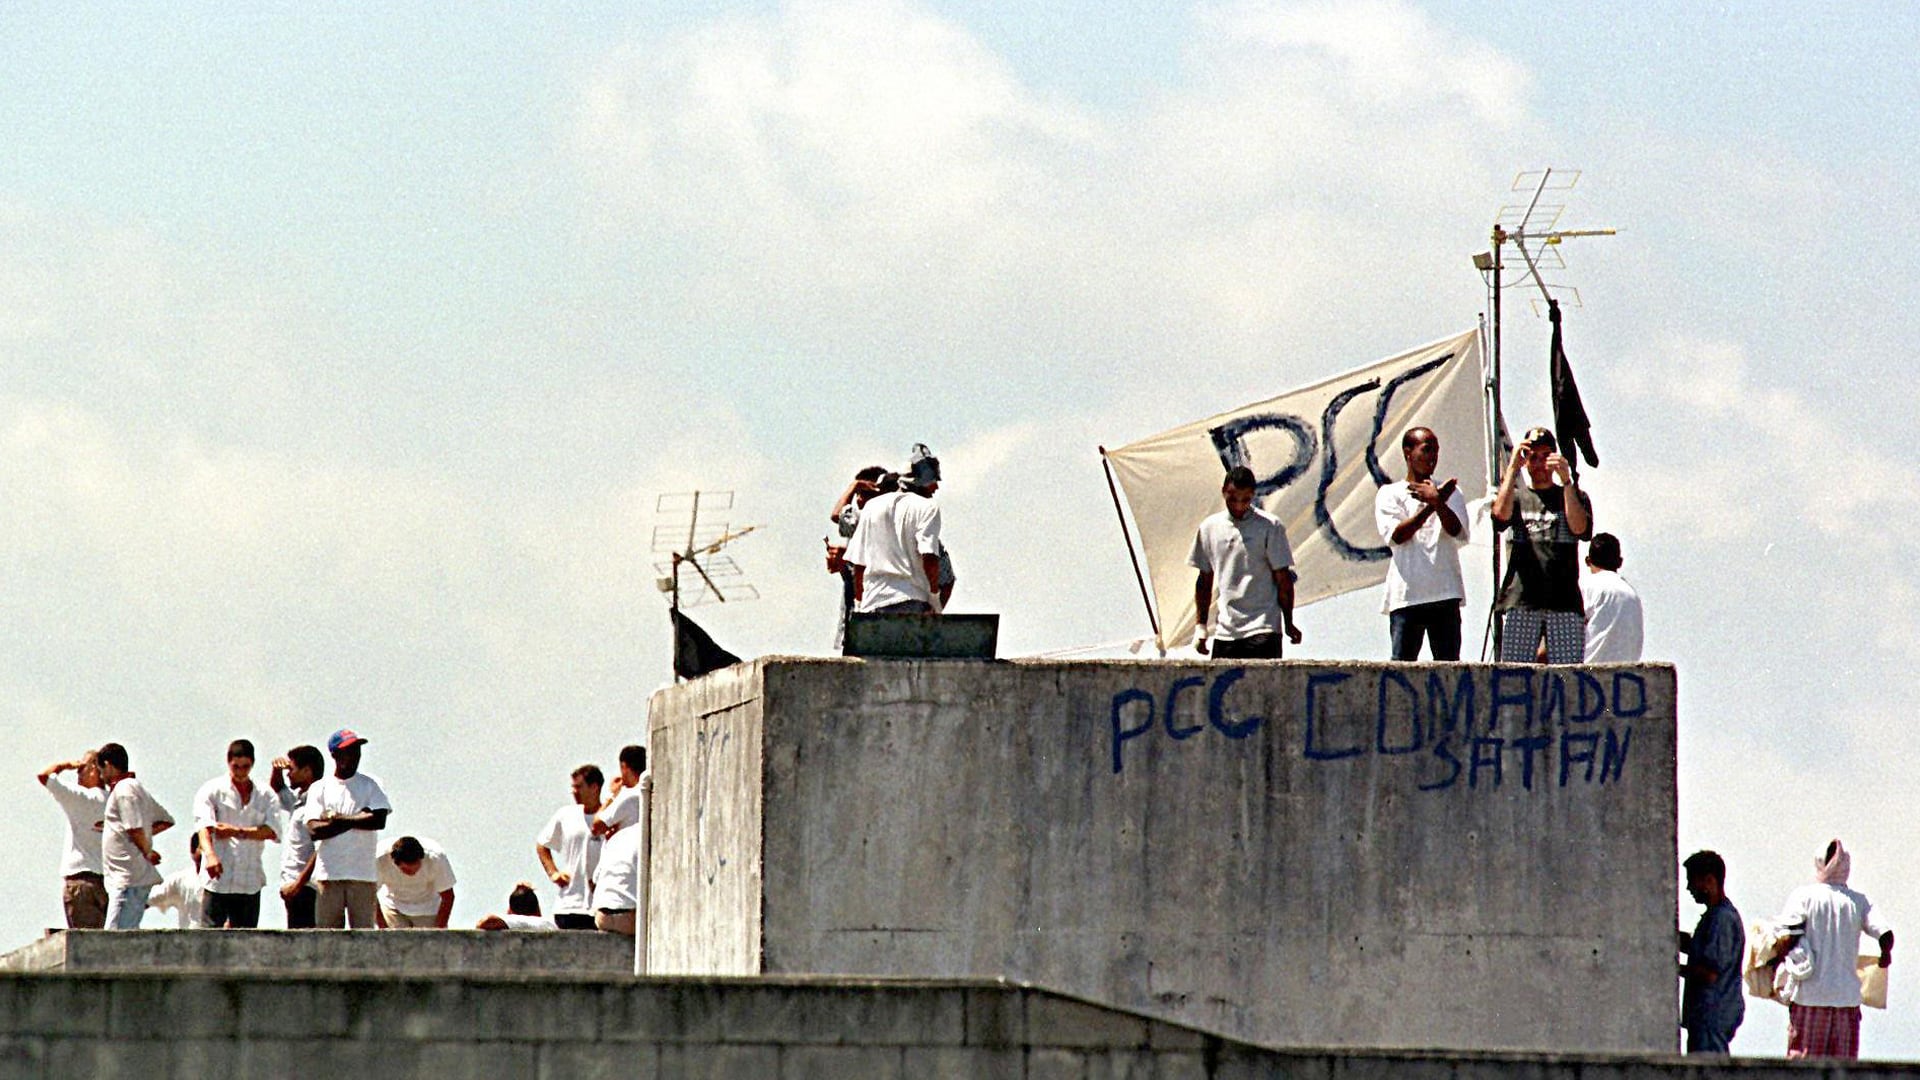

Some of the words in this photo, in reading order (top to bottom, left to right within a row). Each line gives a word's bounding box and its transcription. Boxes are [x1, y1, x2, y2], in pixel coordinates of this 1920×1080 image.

[1112, 668, 1265, 774] PCC
[1304, 667, 1647, 760] COMANDO
[1418, 726, 1633, 792] SATAN
